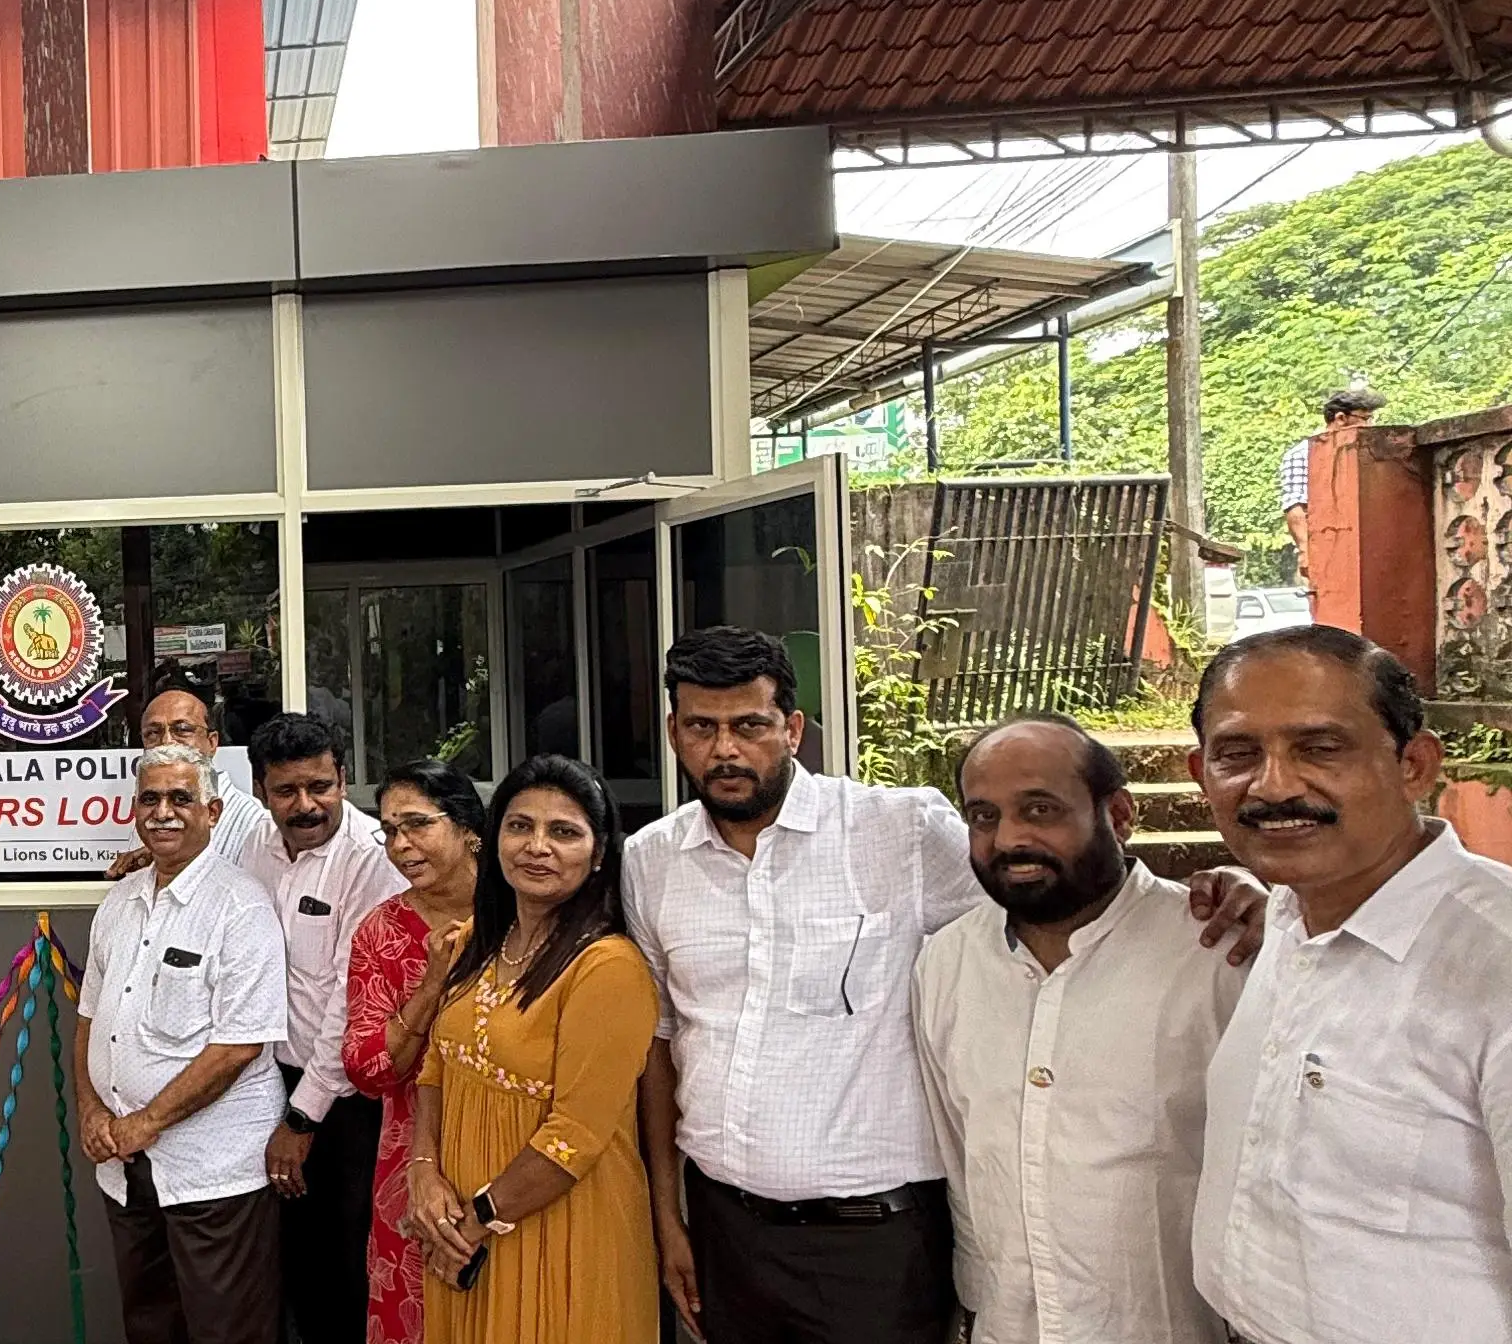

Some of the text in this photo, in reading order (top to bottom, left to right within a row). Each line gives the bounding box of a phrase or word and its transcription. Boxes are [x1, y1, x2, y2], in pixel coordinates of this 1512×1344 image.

[57, 795, 136, 826] LOU
[3, 847, 48, 862] Lions
[52, 847, 94, 862] Club,
